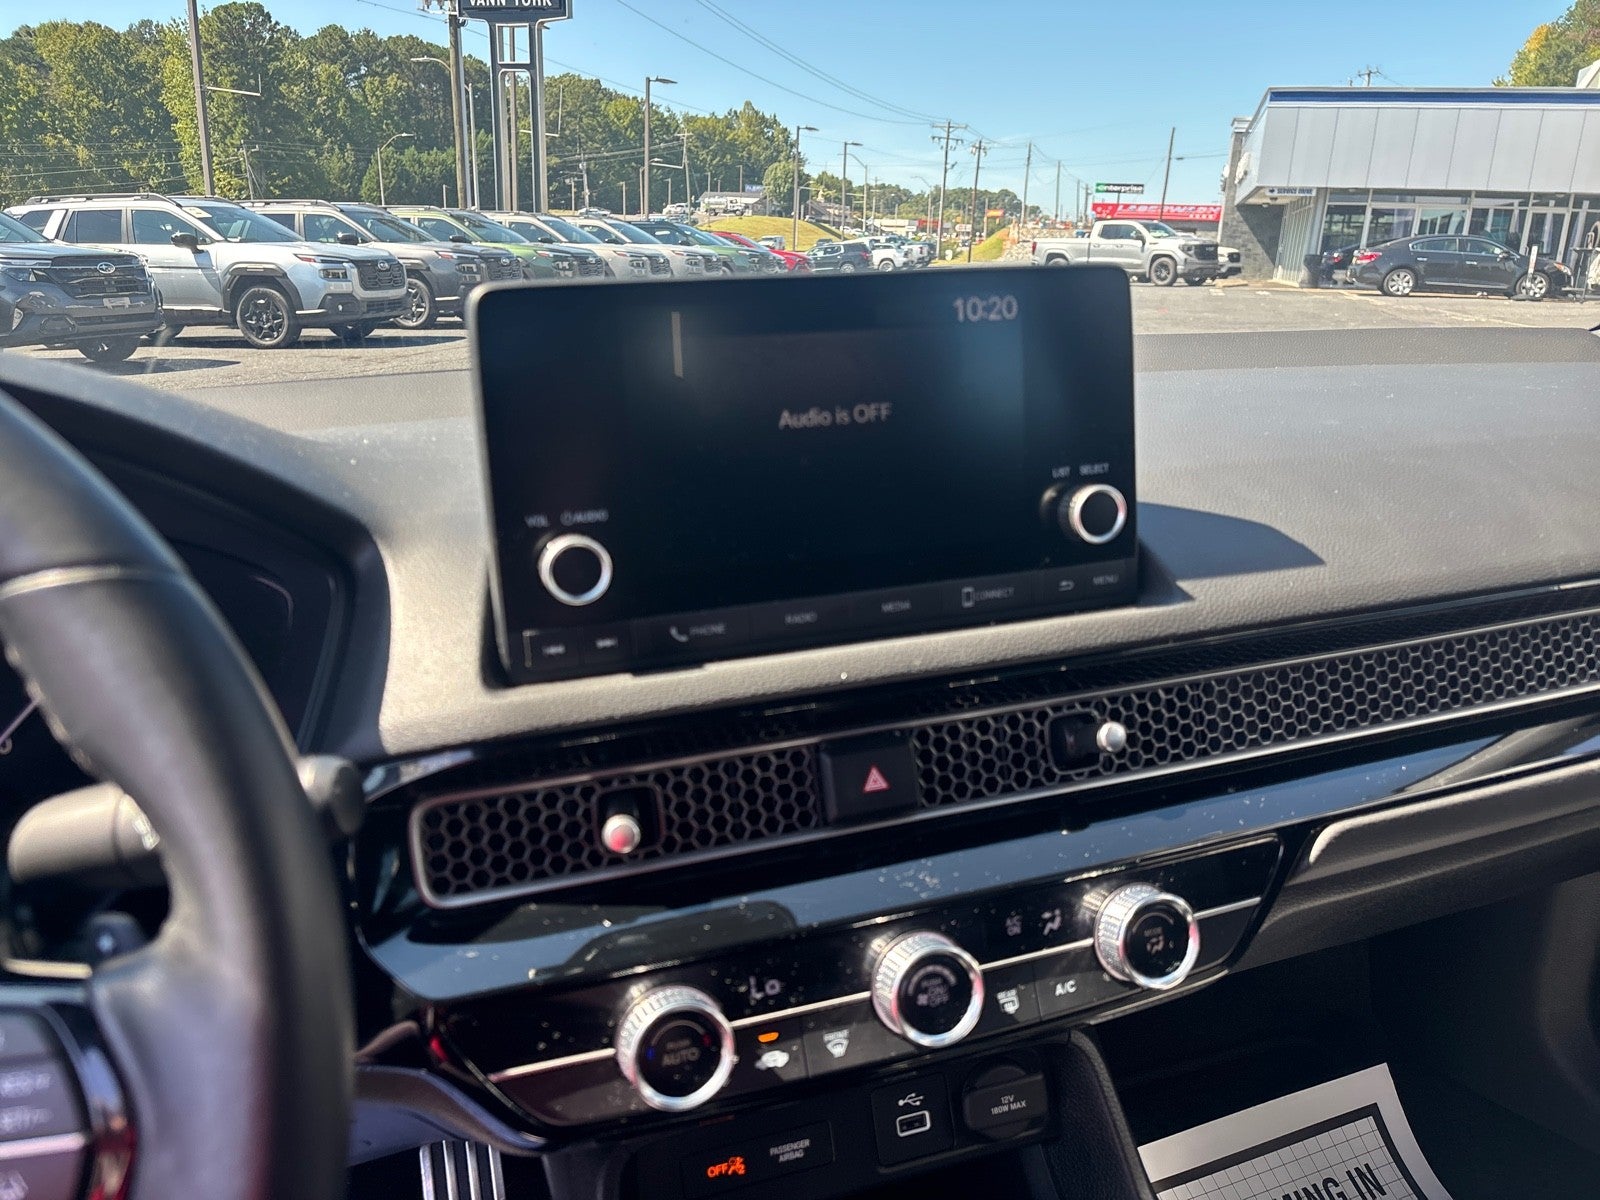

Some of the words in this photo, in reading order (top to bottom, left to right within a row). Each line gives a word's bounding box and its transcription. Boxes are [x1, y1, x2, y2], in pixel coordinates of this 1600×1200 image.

[953, 295, 1018, 322] 10:20
[778, 407, 833, 430] Audio
[835, 406, 850, 425] is
[853, 401, 893, 424] OFF
[1079, 462, 1110, 476] SELECT
[1092, 574, 1120, 586] MENU
[974, 586, 1015, 601] CONNECT
[881, 600, 912, 613] MEDIA
[784, 611, 818, 625] RADIO
[689, 622, 727, 636] PHONE
[749, 975, 782, 1000] Lo
[1055, 979, 1078, 997] A/C
[662, 1047, 701, 1068] AUTO
[1000, 1094, 1015, 1104] 12V
[991, 1104, 1009, 1115] 180W
[1010, 1100, 1026, 1110] MAX
[769, 1139, 810, 1157] PASSENGER
[779, 1148, 805, 1163] AIRBAG
[707, 1162, 728, 1178] OFF
[1345, 1163, 1387, 1200] IN
